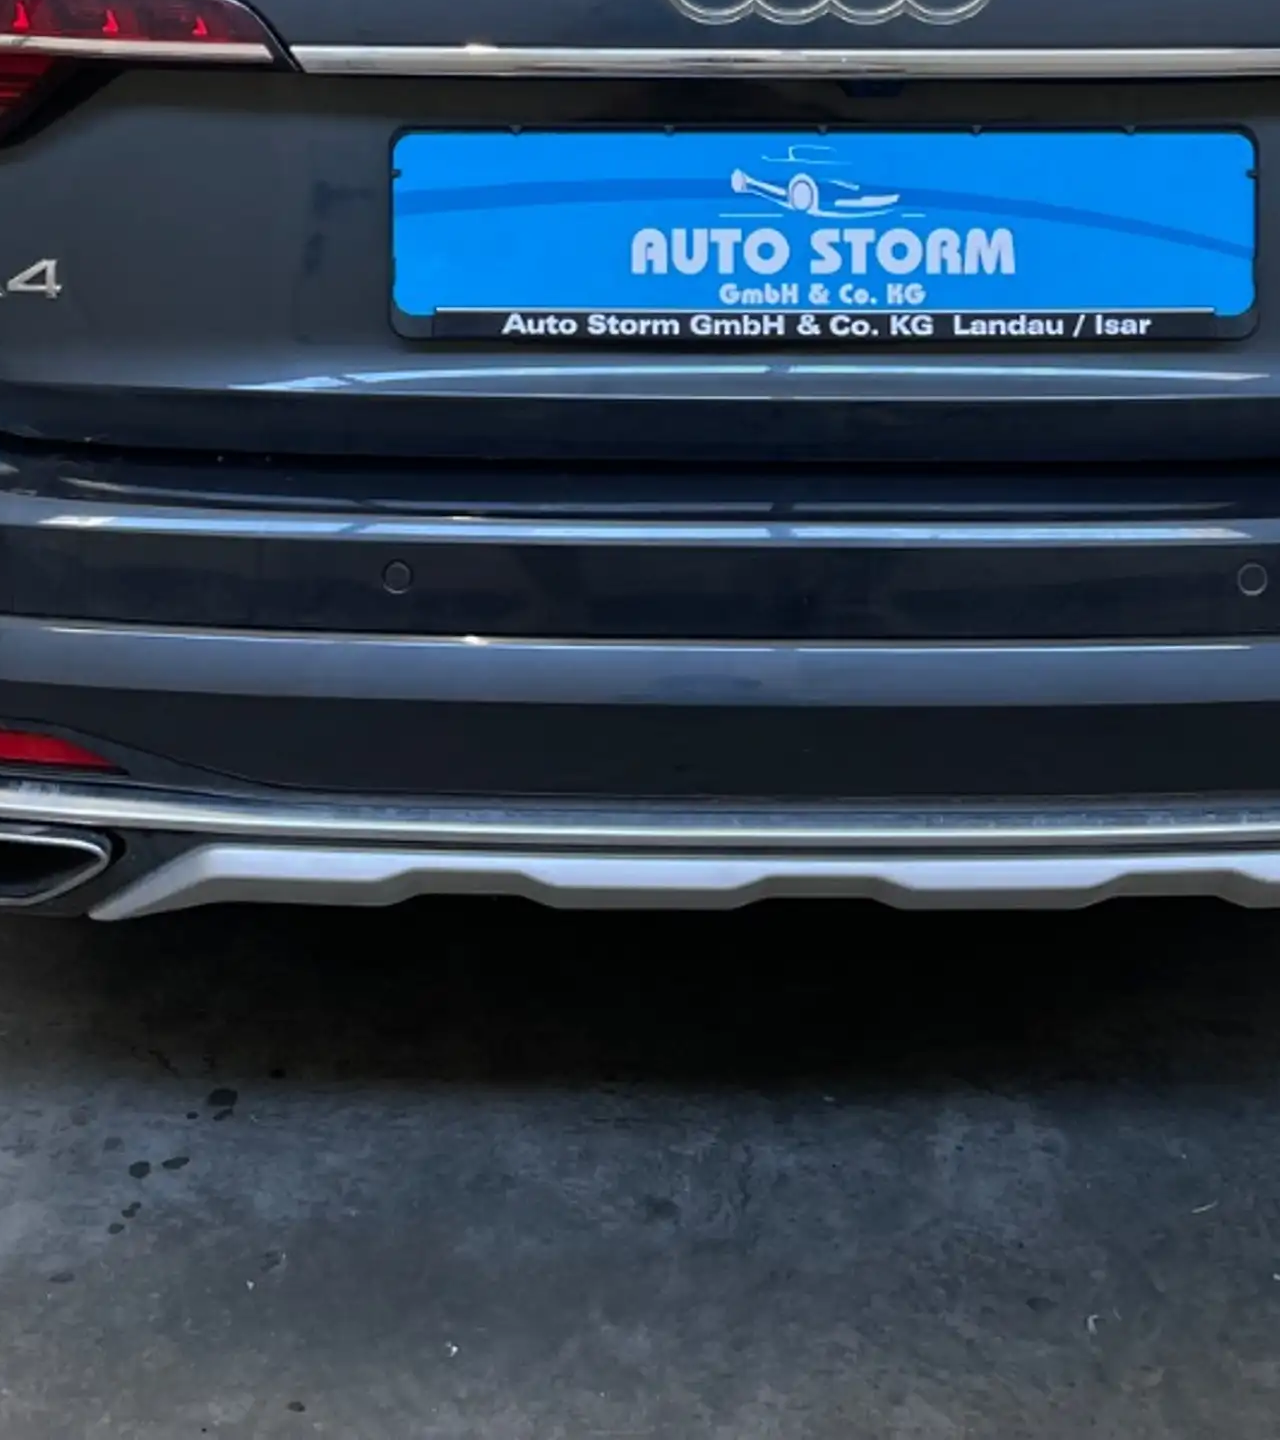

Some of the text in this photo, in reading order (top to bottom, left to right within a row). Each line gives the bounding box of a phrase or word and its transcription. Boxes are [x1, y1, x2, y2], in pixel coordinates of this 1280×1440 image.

[631, 227, 1015, 275] AUTO STORM
[719, 283, 926, 305] GmbH & Co. KG
[502, 313, 1152, 337] Auto Storm GmbH & Co. KG Landau / Isar
